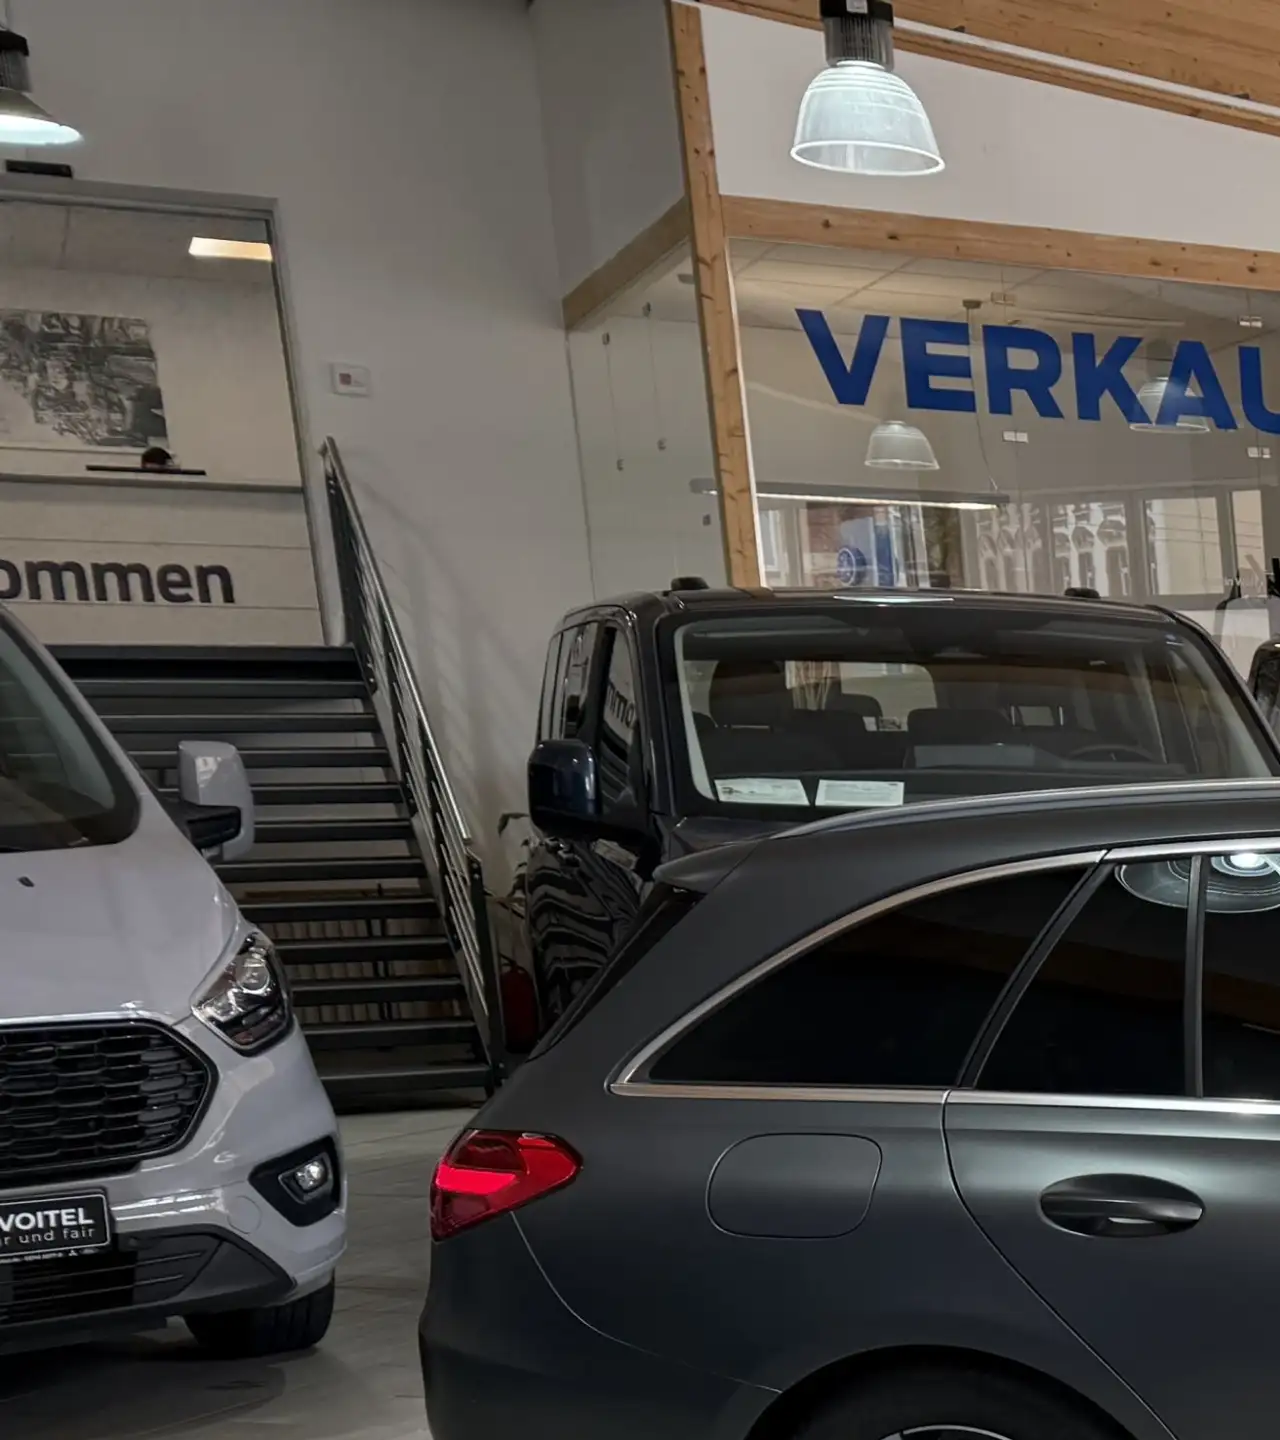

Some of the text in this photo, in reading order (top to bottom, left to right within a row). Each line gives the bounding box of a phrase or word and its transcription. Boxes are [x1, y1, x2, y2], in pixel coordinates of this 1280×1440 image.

[0, 1207, 95, 1232] VOITEL
[19, 1230, 54, 1244] und
[63, 1226, 95, 1239] fair
